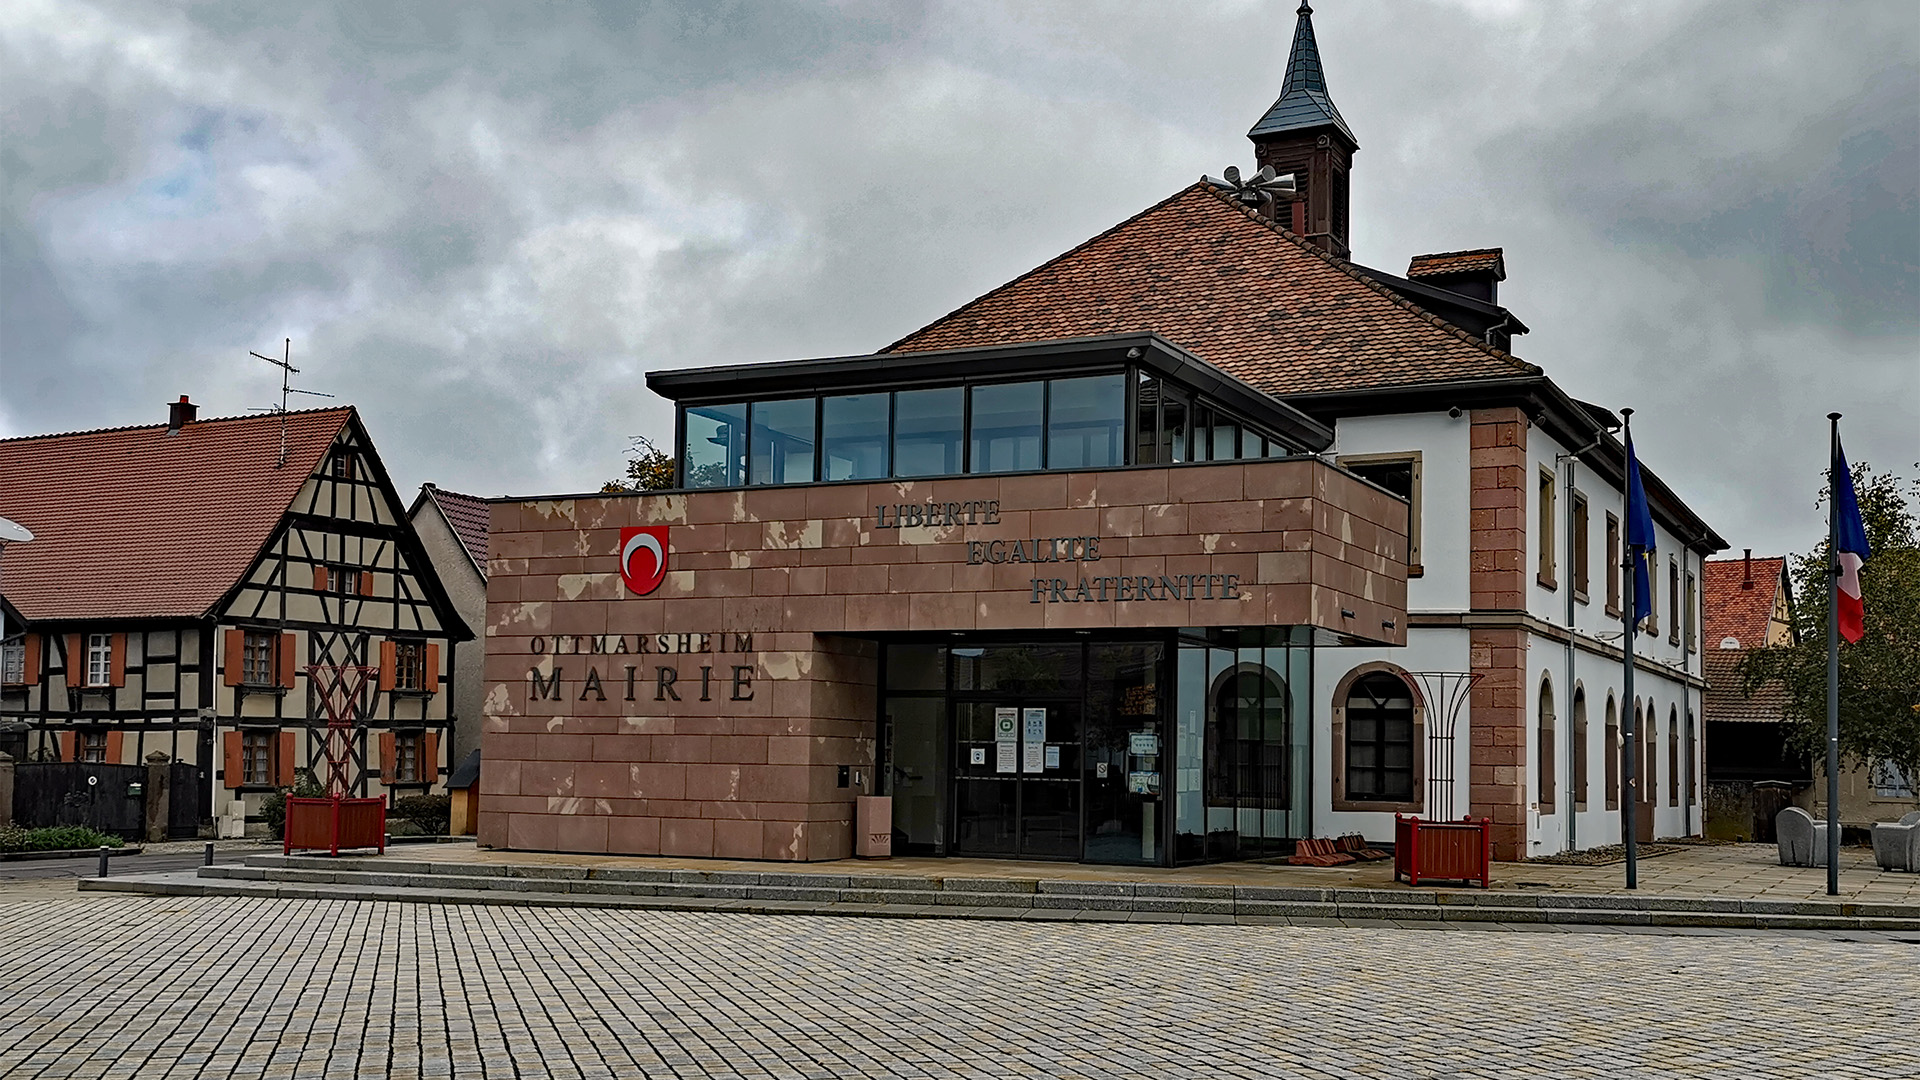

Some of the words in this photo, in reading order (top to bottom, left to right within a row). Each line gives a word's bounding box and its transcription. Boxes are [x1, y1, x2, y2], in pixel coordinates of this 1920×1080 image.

[875, 500, 1001, 529] LIBERTE
[966, 536, 1101, 566] EGALITE
[1030, 573, 1241, 604] FRATERNITE
[530, 633, 753, 656] OTTMARSHEIM
[529, 665, 755, 702] MAIRIE
